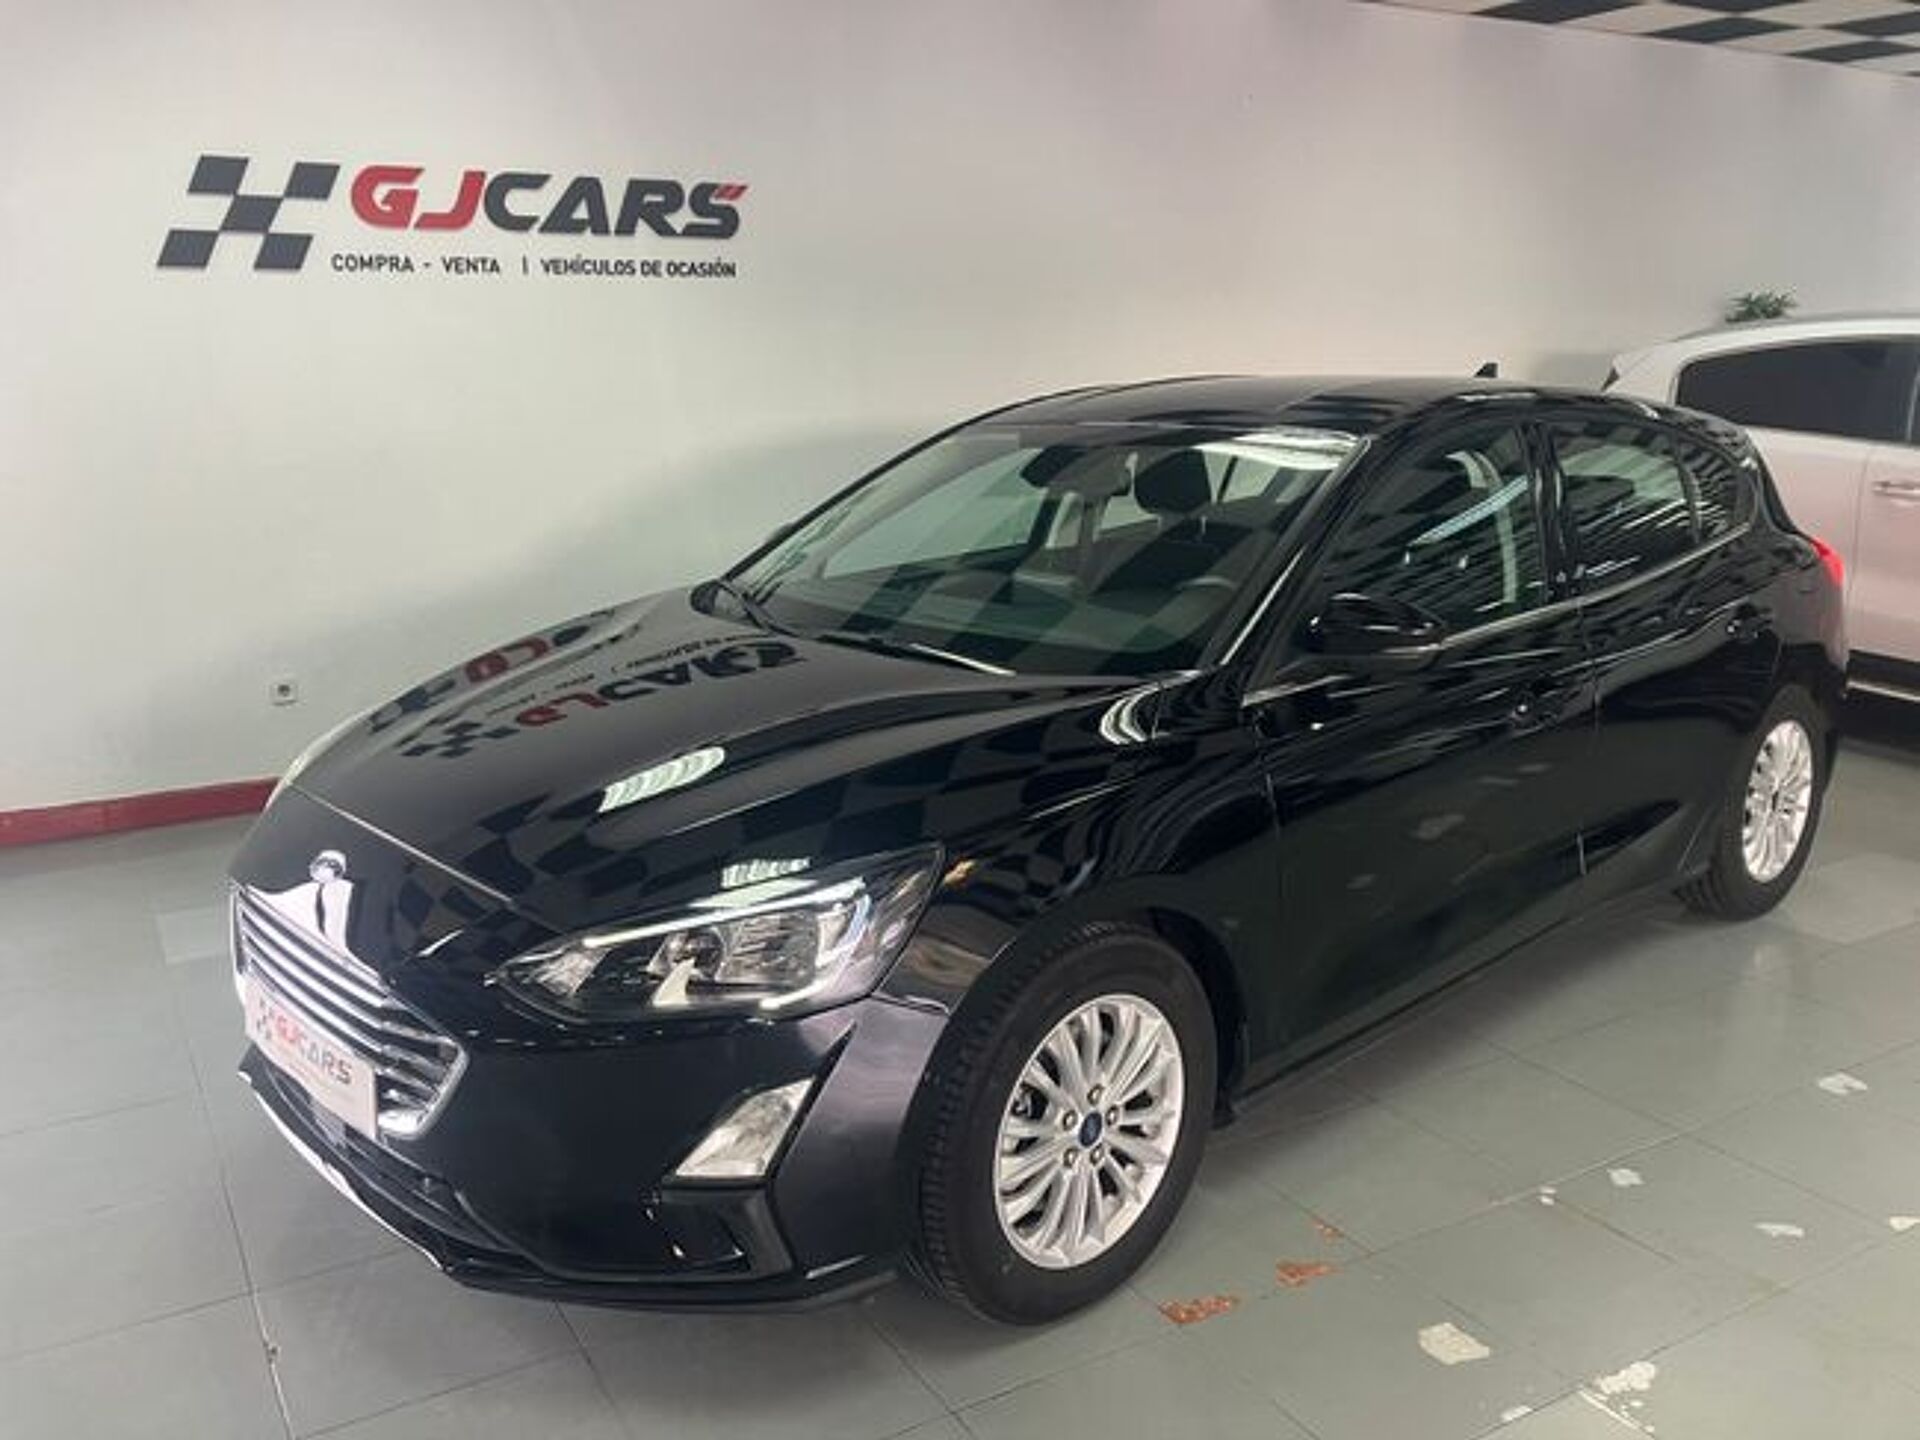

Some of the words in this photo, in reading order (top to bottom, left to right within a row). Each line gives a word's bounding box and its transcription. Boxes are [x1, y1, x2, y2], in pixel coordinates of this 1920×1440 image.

[350, 164, 749, 240] GJCARS
[331, 253, 414, 273] COMPRA
[441, 256, 501, 275] VENTA
[540, 253, 636, 276] VEHÍCULOS
[640, 259, 663, 277] DE
[666, 256, 737, 278] OCASIÓN
